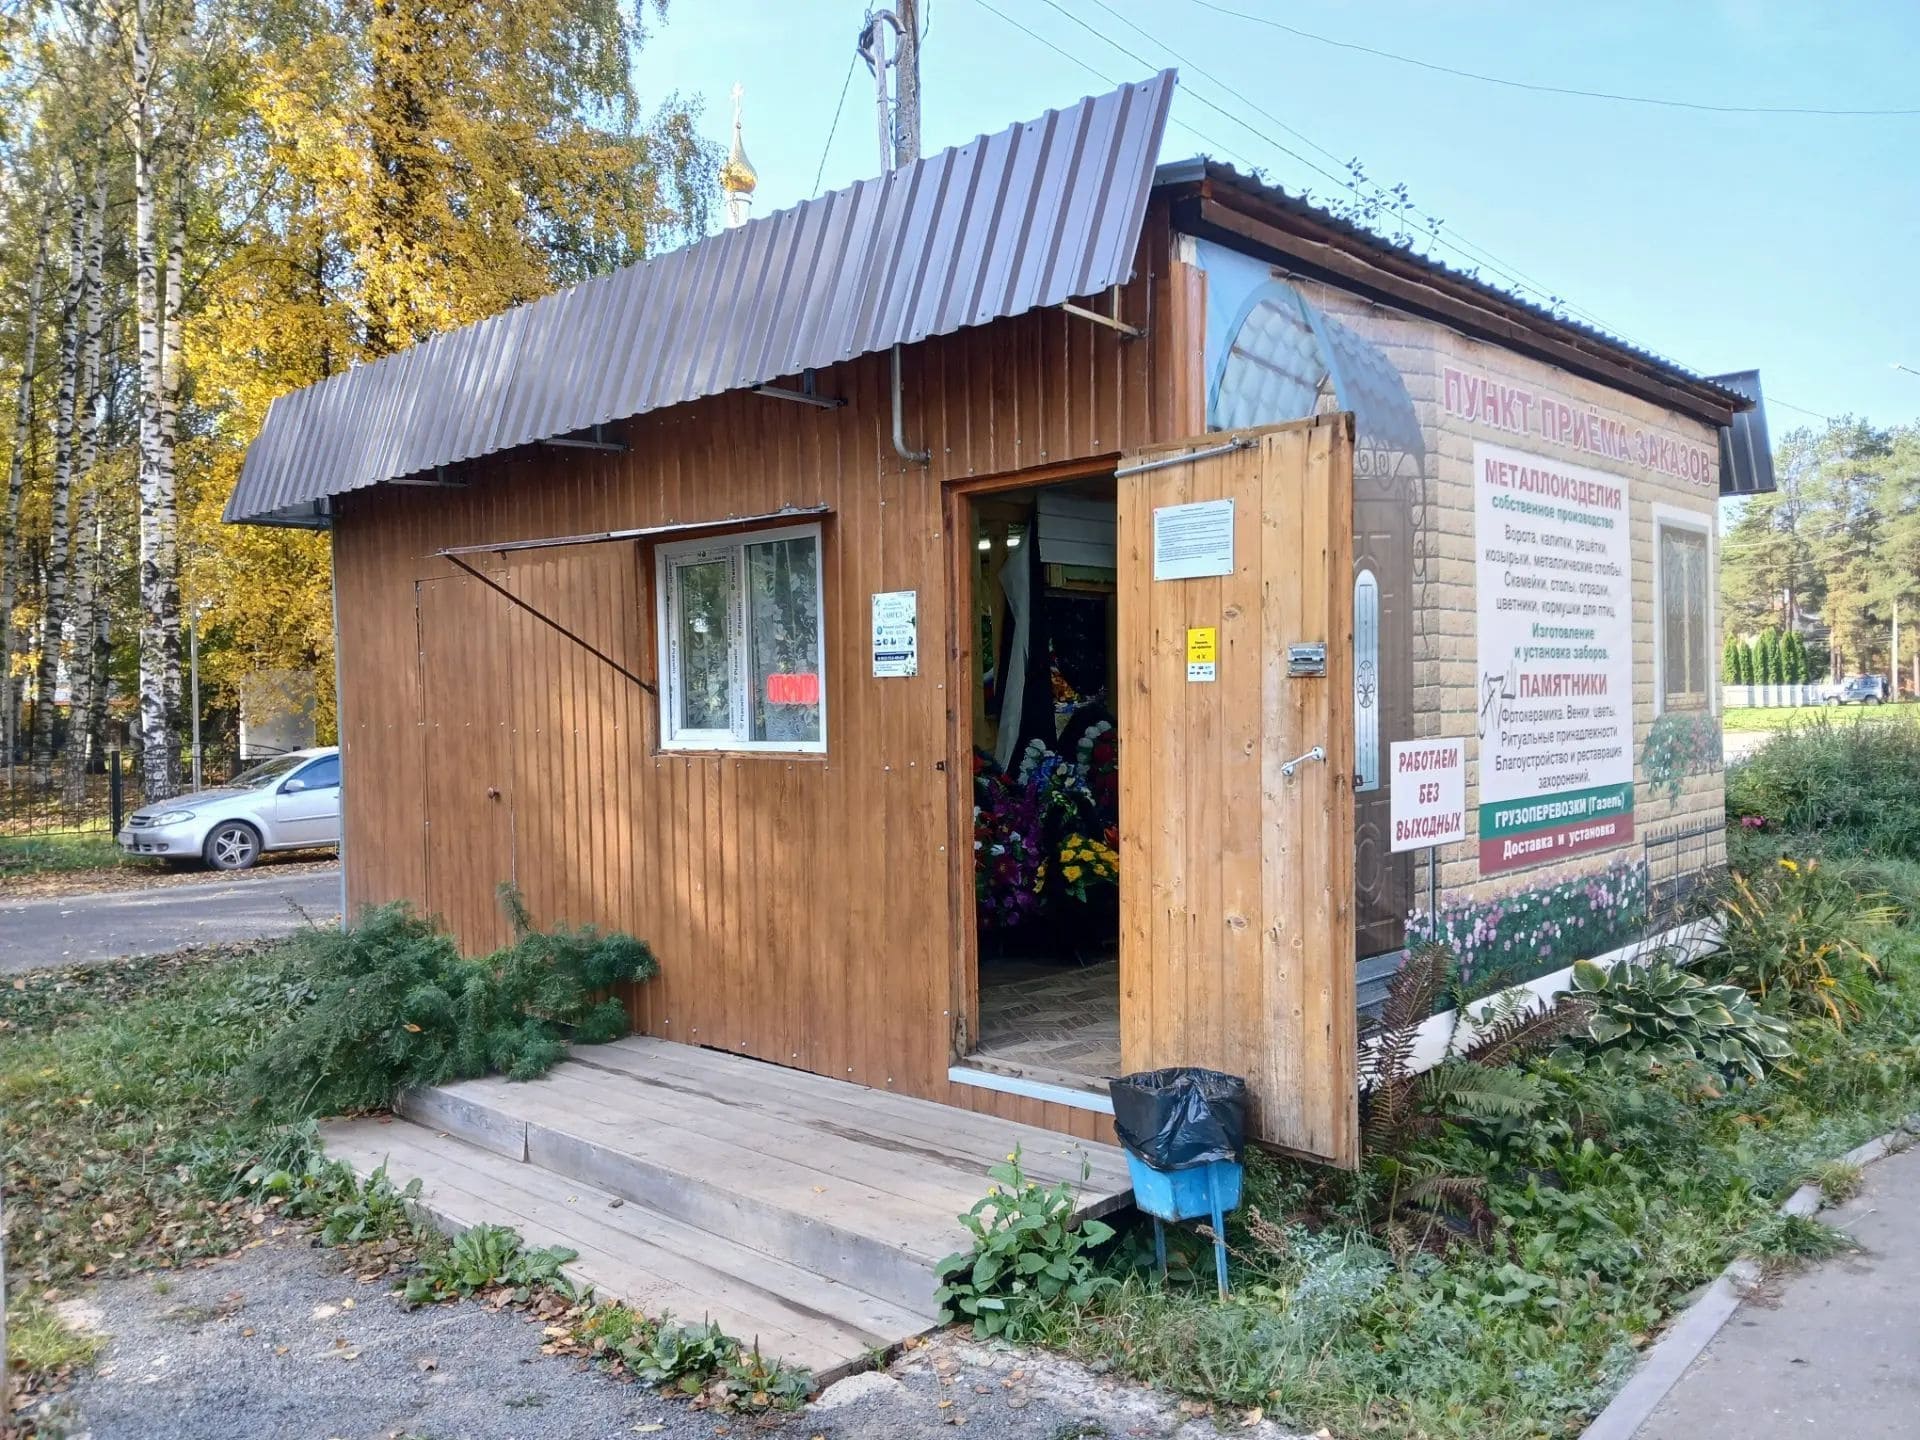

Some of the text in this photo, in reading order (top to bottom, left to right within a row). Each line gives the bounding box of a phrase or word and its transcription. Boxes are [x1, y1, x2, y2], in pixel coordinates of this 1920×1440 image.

[1443, 366, 1710, 485] ПУНКТ ПРИЁМА ЗАКАЗОВ
[1485, 458, 1622, 510] МЕТАЛЛОИЗДЕЛИЯ
[1492, 494, 1614, 529] собственное производство
[1534, 555, 1593, 573] металлические
[1541, 601, 1581, 618] кормушки
[1582, 604, 1597, 616] для
[1532, 622, 1595, 640] Изготовление
[1514, 646, 1521, 658] и
[1523, 645, 1571, 663] установка
[1519, 673, 1608, 698] ПАМЯТНИКИ
[1501, 725, 1618, 750] Ритуальные принадлежности
[1398, 747, 1458, 773] РАБОТАЕМ
[1495, 746, 1622, 773] Благоустройство и реставрация
[1418, 782, 1440, 804] БЕЗ
[1495, 792, 1625, 829] ГРУЗОПЕРЕВОЗКИ (Газель)
[1396, 811, 1462, 841] ВЫХОДНЫХ
[1503, 823, 1616, 860] Доставка и установка
